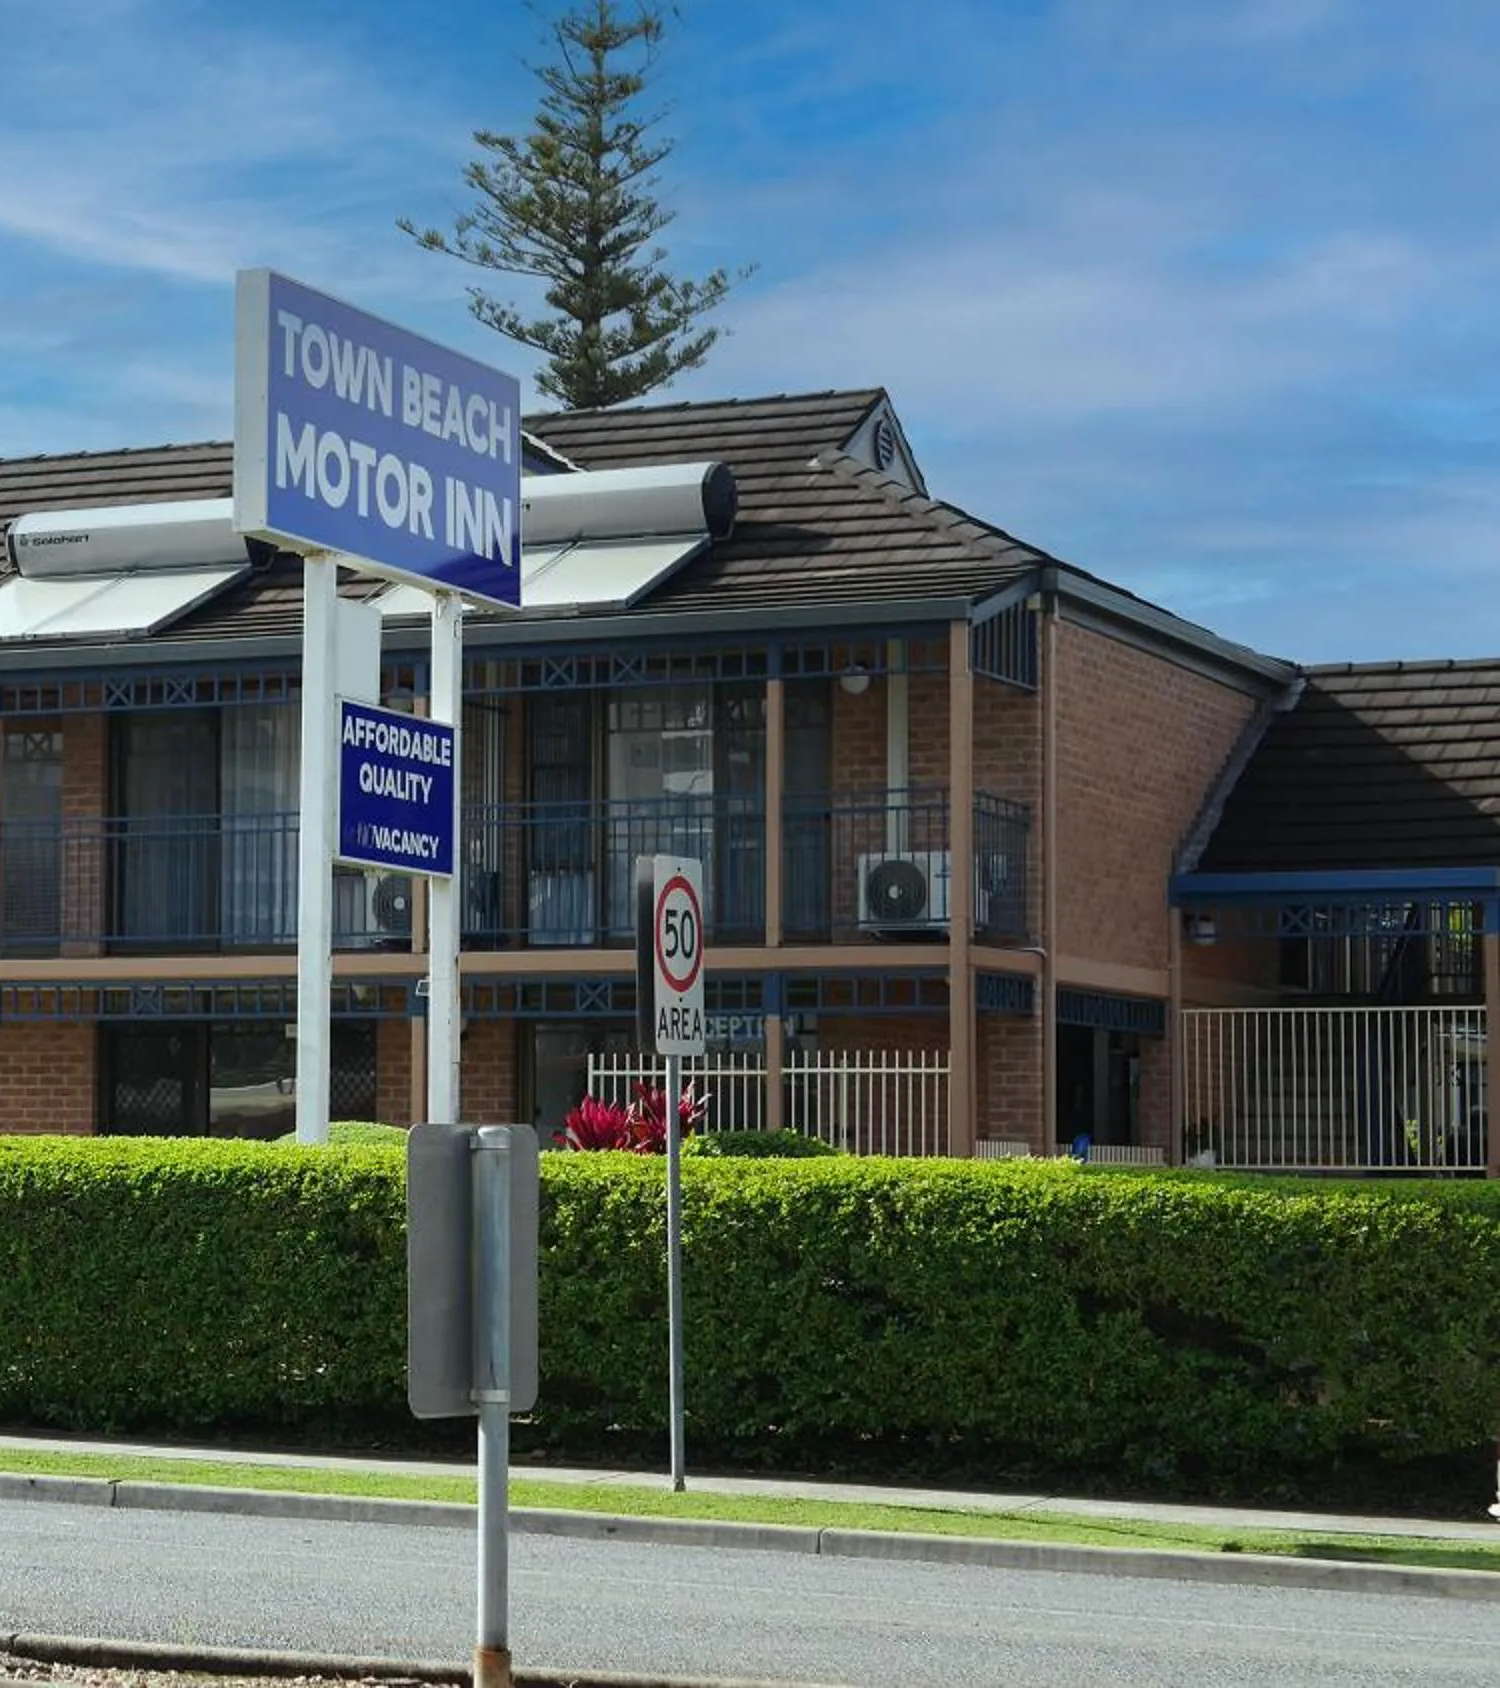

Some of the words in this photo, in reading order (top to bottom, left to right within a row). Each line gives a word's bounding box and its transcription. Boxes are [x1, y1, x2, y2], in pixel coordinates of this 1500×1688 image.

[277, 309, 393, 417] TOWN
[403, 364, 512, 465] BEACH
[276, 412, 435, 540] MOTOR
[445, 476, 513, 567] INN
[343, 715, 451, 767] AFFORDABLE
[359, 762, 433, 804] QUALITY
[372, 824, 440, 859] VACANCY
[664, 909, 695, 960] 50
[657, 1007, 703, 1041] AREA
